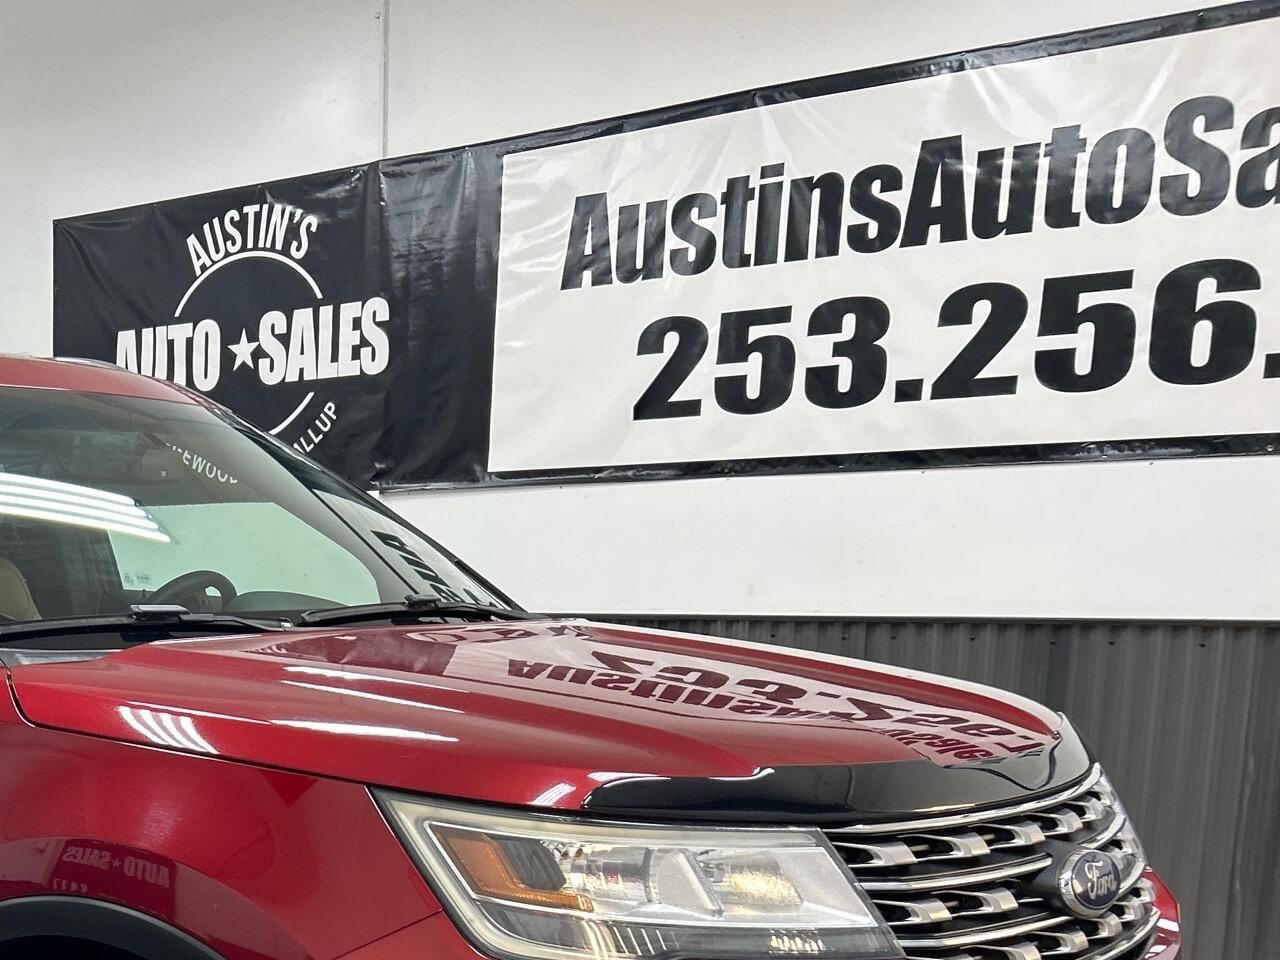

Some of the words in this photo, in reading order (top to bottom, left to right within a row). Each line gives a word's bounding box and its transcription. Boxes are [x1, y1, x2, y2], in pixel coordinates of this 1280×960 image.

[560, 96, 1280, 290] AustinsAutoSa
[186, 203, 318, 276] AUSTIN'S
[116, 319, 221, 391] AUTO
[258, 297, 390, 386] SALES
[1084, 860, 1117, 900] Ford
